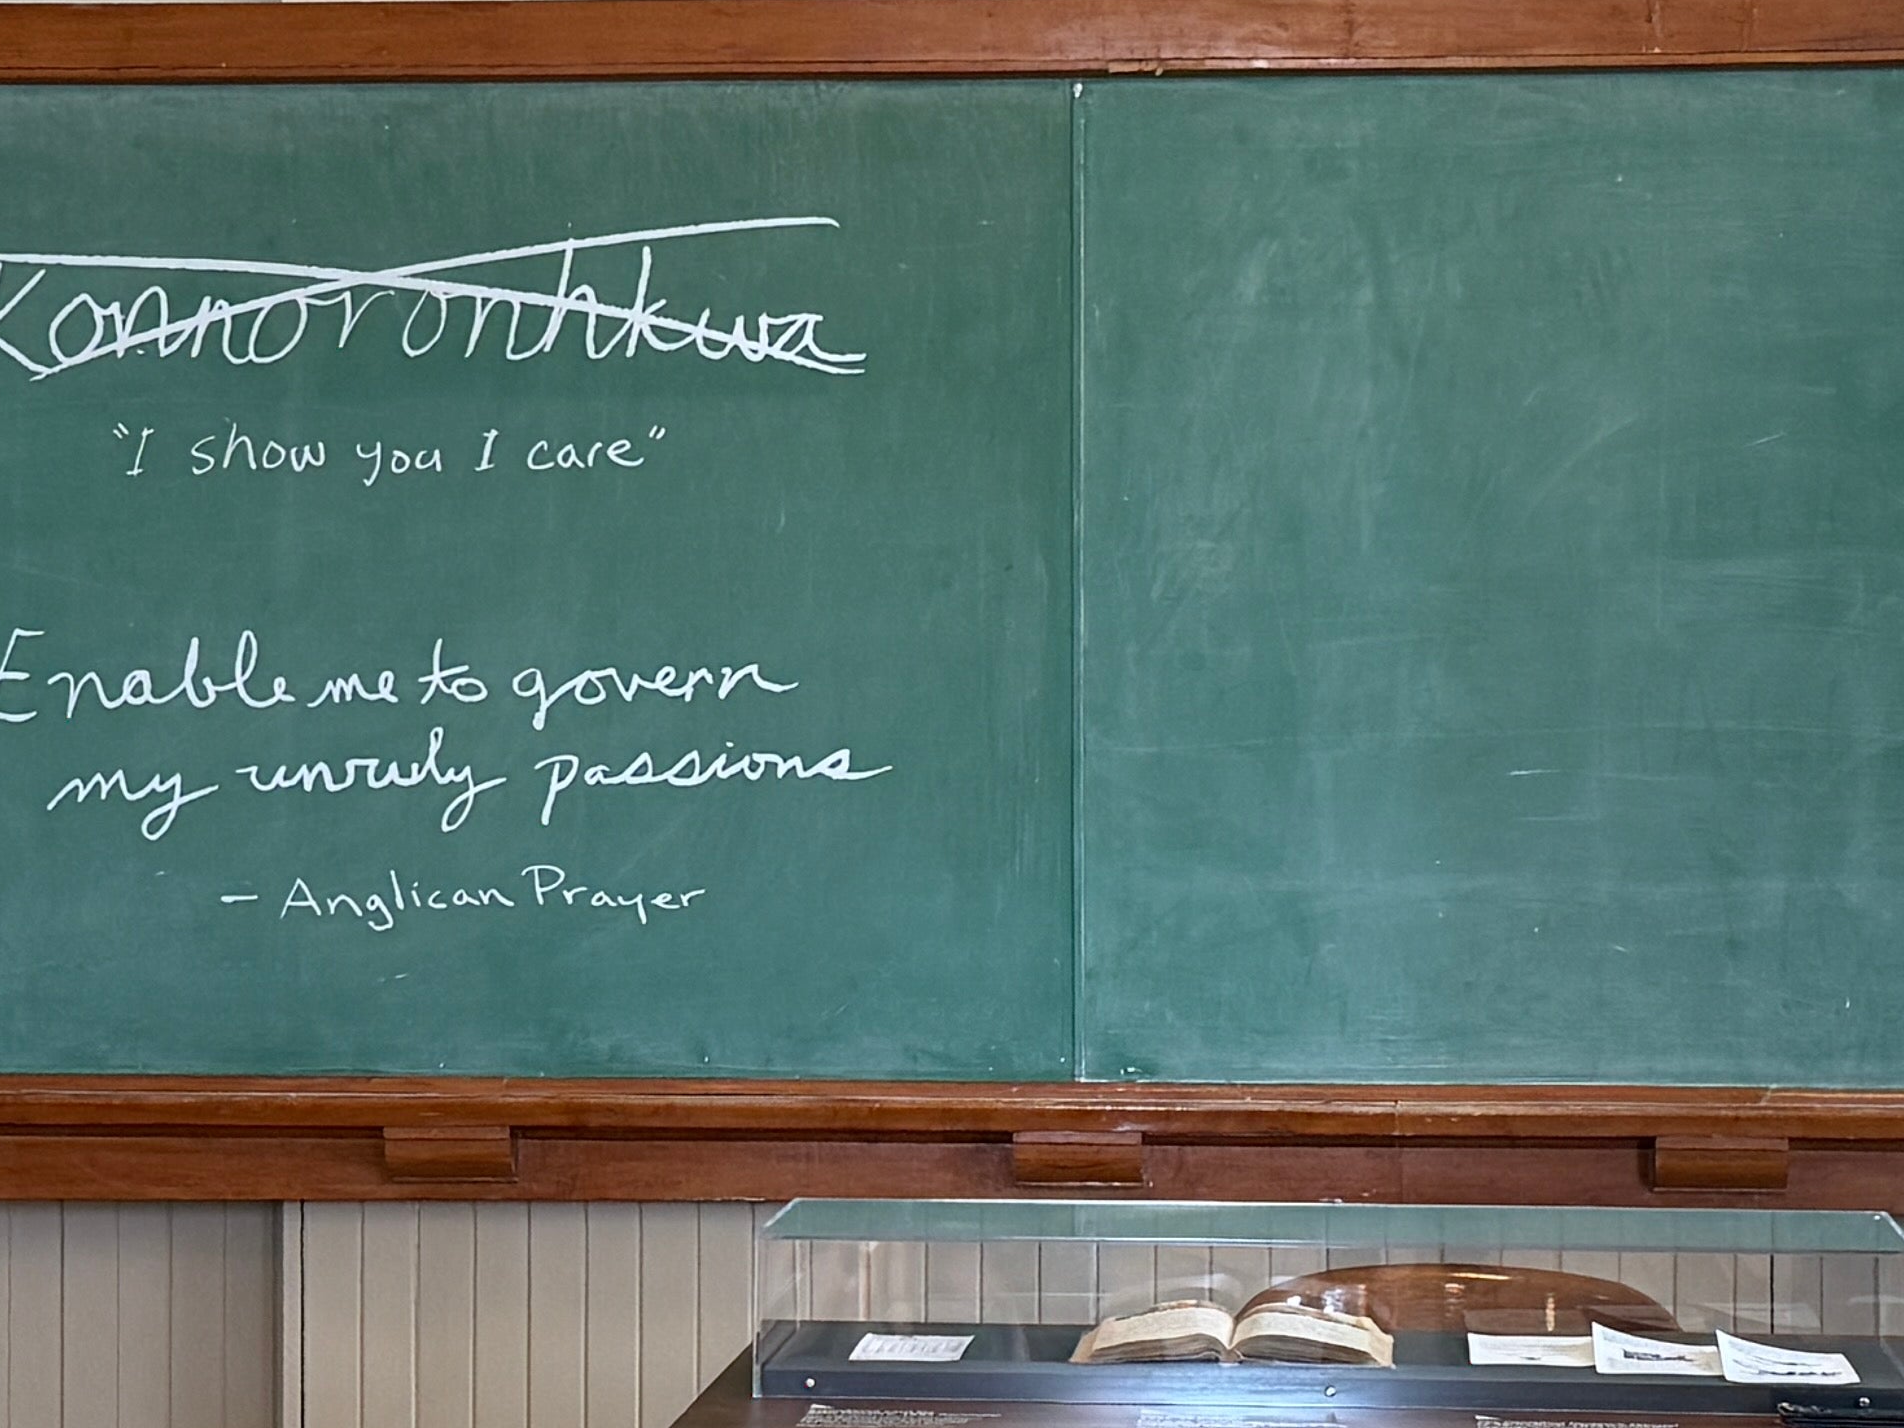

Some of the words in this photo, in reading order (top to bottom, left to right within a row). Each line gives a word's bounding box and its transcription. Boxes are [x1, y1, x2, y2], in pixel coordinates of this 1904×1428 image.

[192, 422, 326, 476] show
[356, 441, 442, 486] you
[474, 429, 499, 472] I
[307, 670, 398, 707] me
[418, 638, 488, 705] to
[512, 663, 800, 731] govern
[46, 768, 220, 841] my
[235, 726, 507, 833] unruly
[534, 741, 894, 826] passions
[280, 869, 515, 932] Anglican
[521, 865, 706, 925] Prayer
